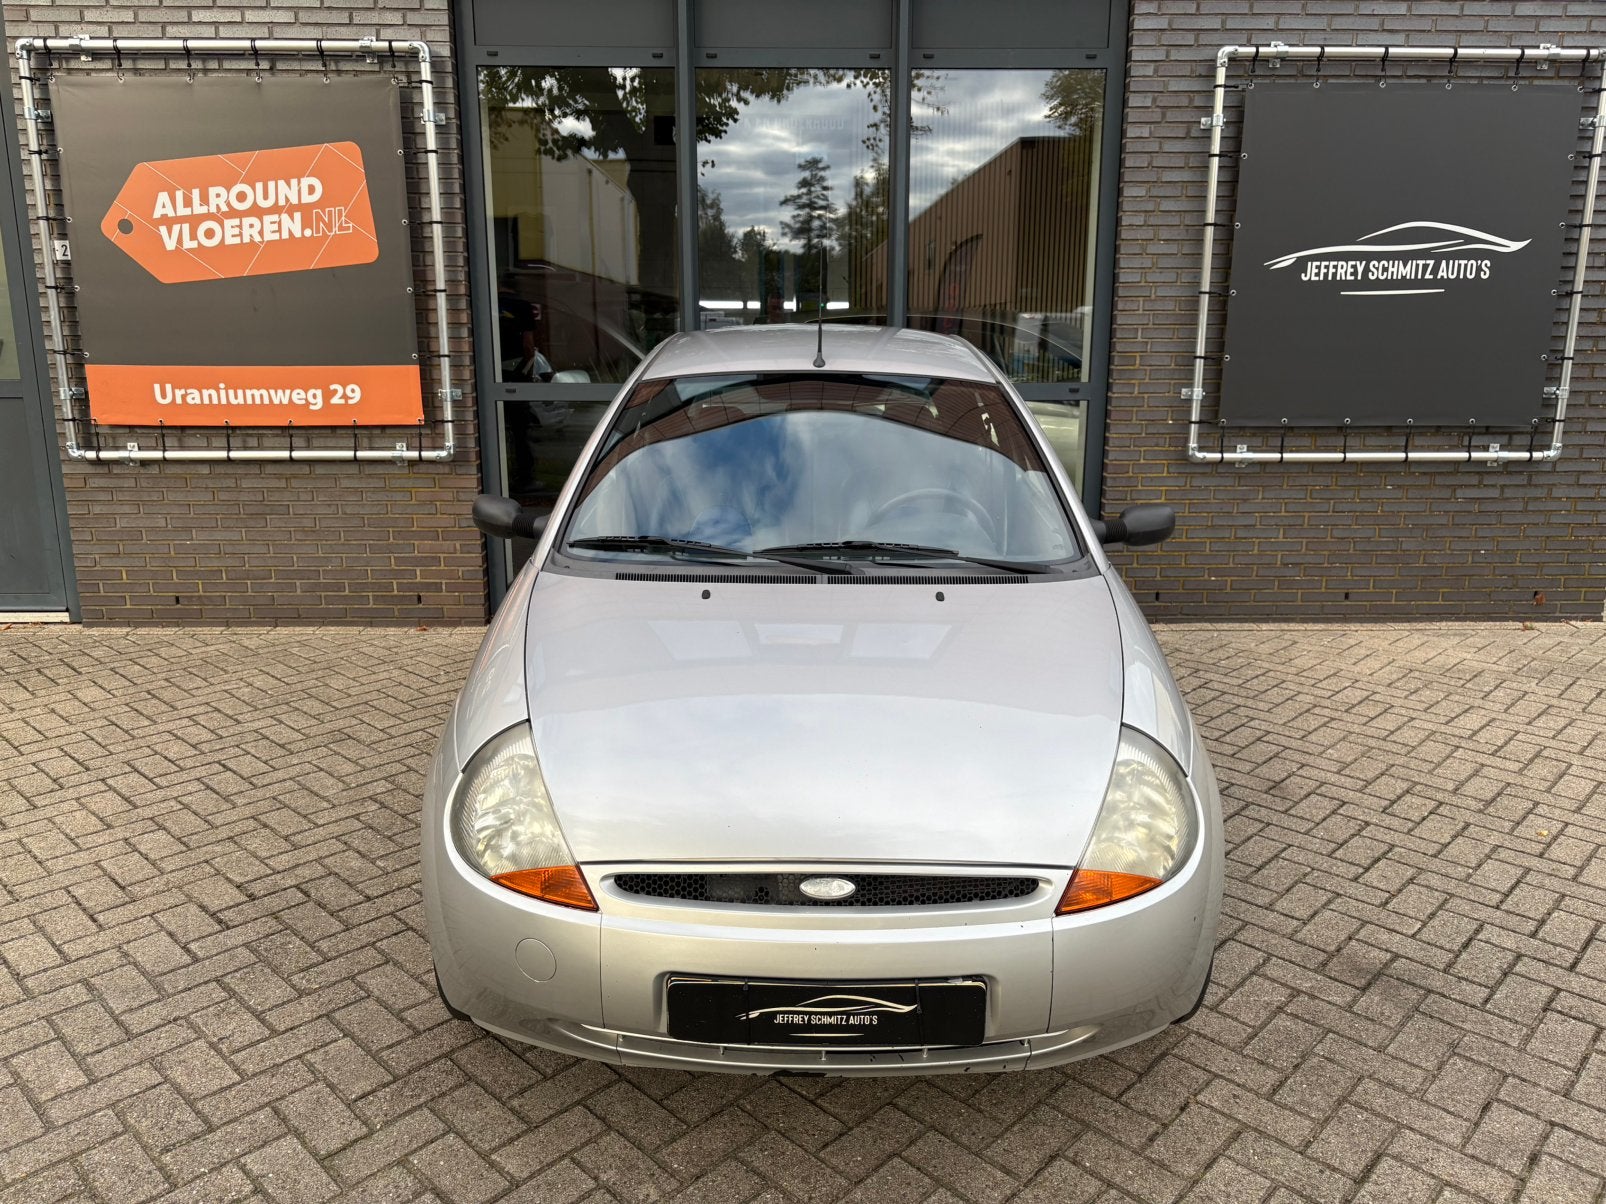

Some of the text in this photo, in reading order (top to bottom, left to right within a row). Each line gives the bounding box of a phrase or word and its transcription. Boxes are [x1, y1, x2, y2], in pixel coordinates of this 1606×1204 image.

[152, 176, 323, 219] ALLROUND
[1301, 259, 1491, 281] JEFFREY SCHMITZ AUTO'S
[152, 382, 362, 410] Uraniumweg 29
[773, 1013, 878, 1025] JEFFREY SCHMITZ AUTO'S
